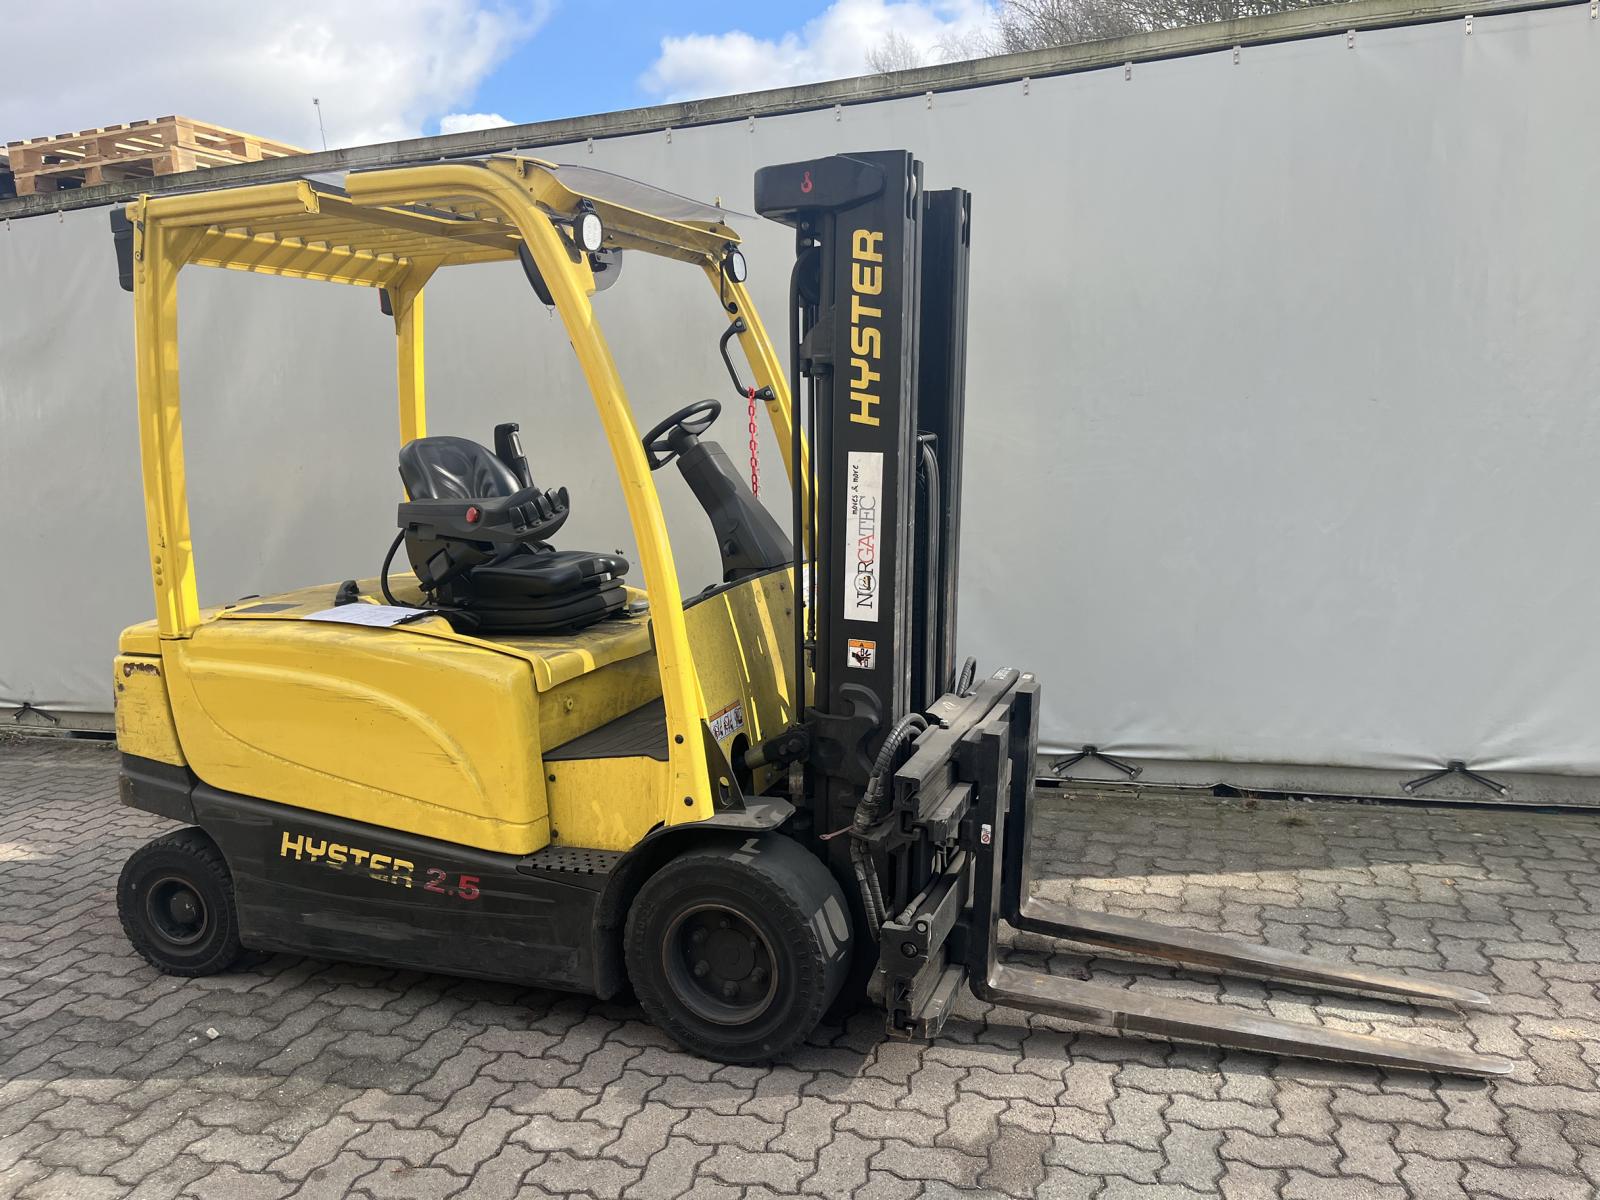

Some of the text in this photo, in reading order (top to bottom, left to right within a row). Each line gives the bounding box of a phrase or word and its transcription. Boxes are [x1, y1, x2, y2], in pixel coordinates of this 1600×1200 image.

[850, 229, 884, 427] HYSTER
[854, 495, 877, 609] NORGATEC
[280, 831, 481, 901] HYSTER 2.5
